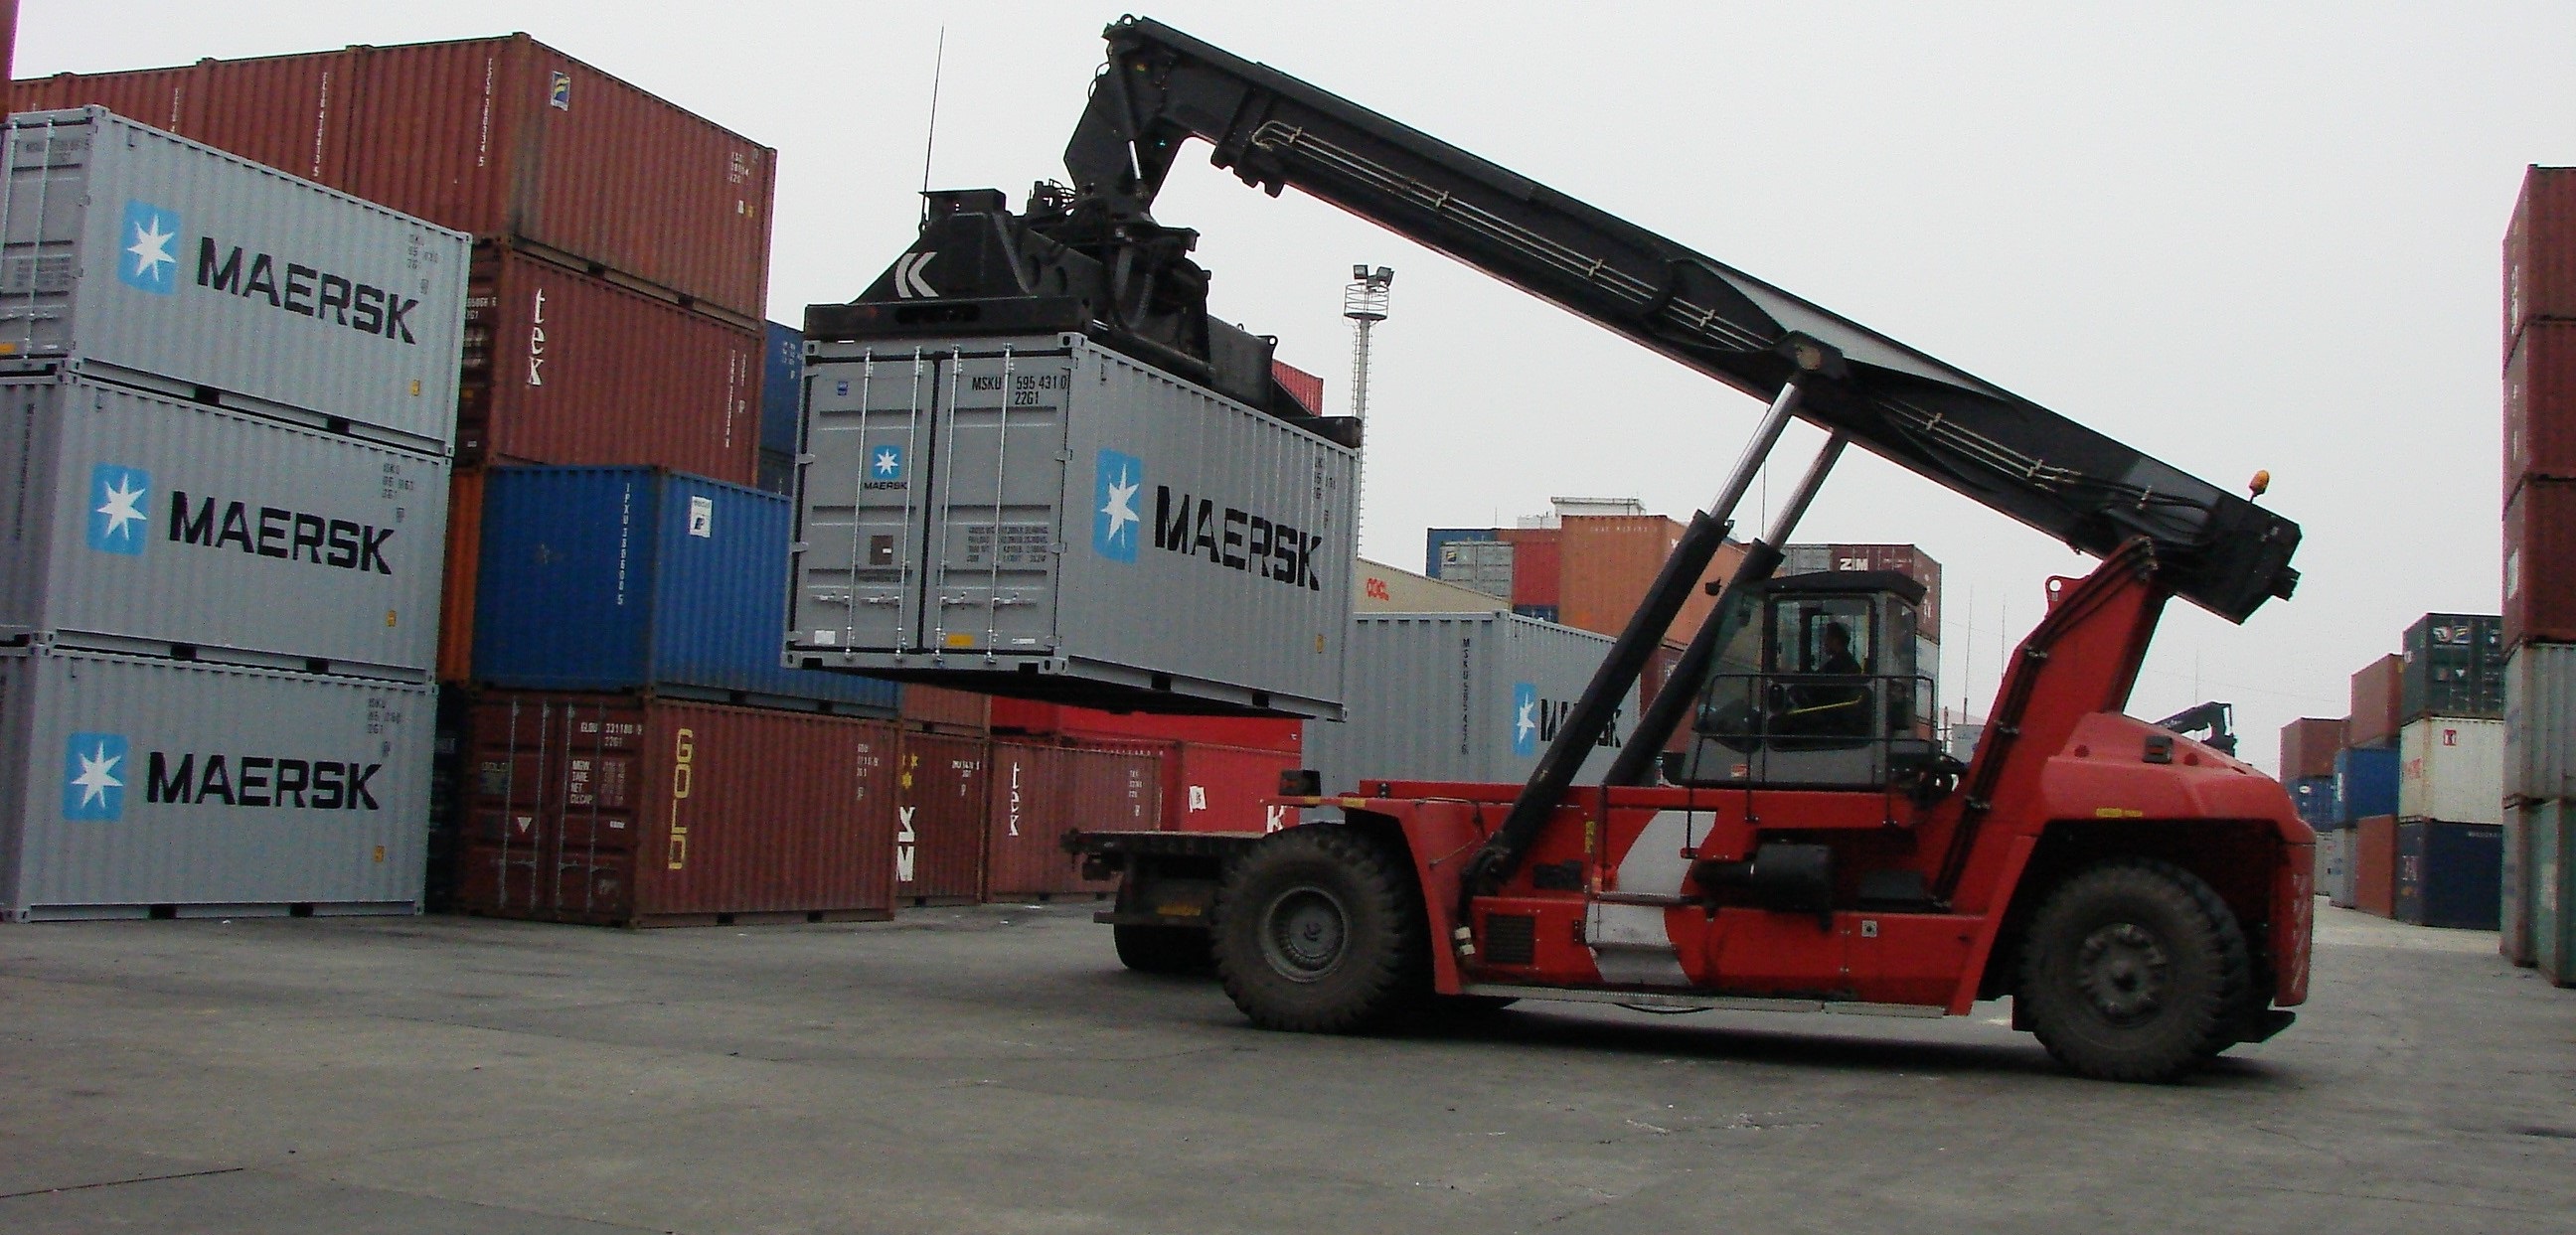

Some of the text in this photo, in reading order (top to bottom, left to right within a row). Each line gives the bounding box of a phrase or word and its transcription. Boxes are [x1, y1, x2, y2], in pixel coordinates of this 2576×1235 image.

[197, 236, 418, 345] MAERSK
[972, 377, 1002, 390] MSKU
[1016, 376, 1036, 390] 595
[1039, 376, 1057, 389] 431
[1015, 391, 1040, 405] 22G1
[864, 482, 907, 491] MAERSK
[169, 490, 394, 575] MAERSK
[1155, 485, 1322, 591] MAERSK
[147, 752, 383, 810] MAERSK
[668, 728, 694, 869] GOLD
